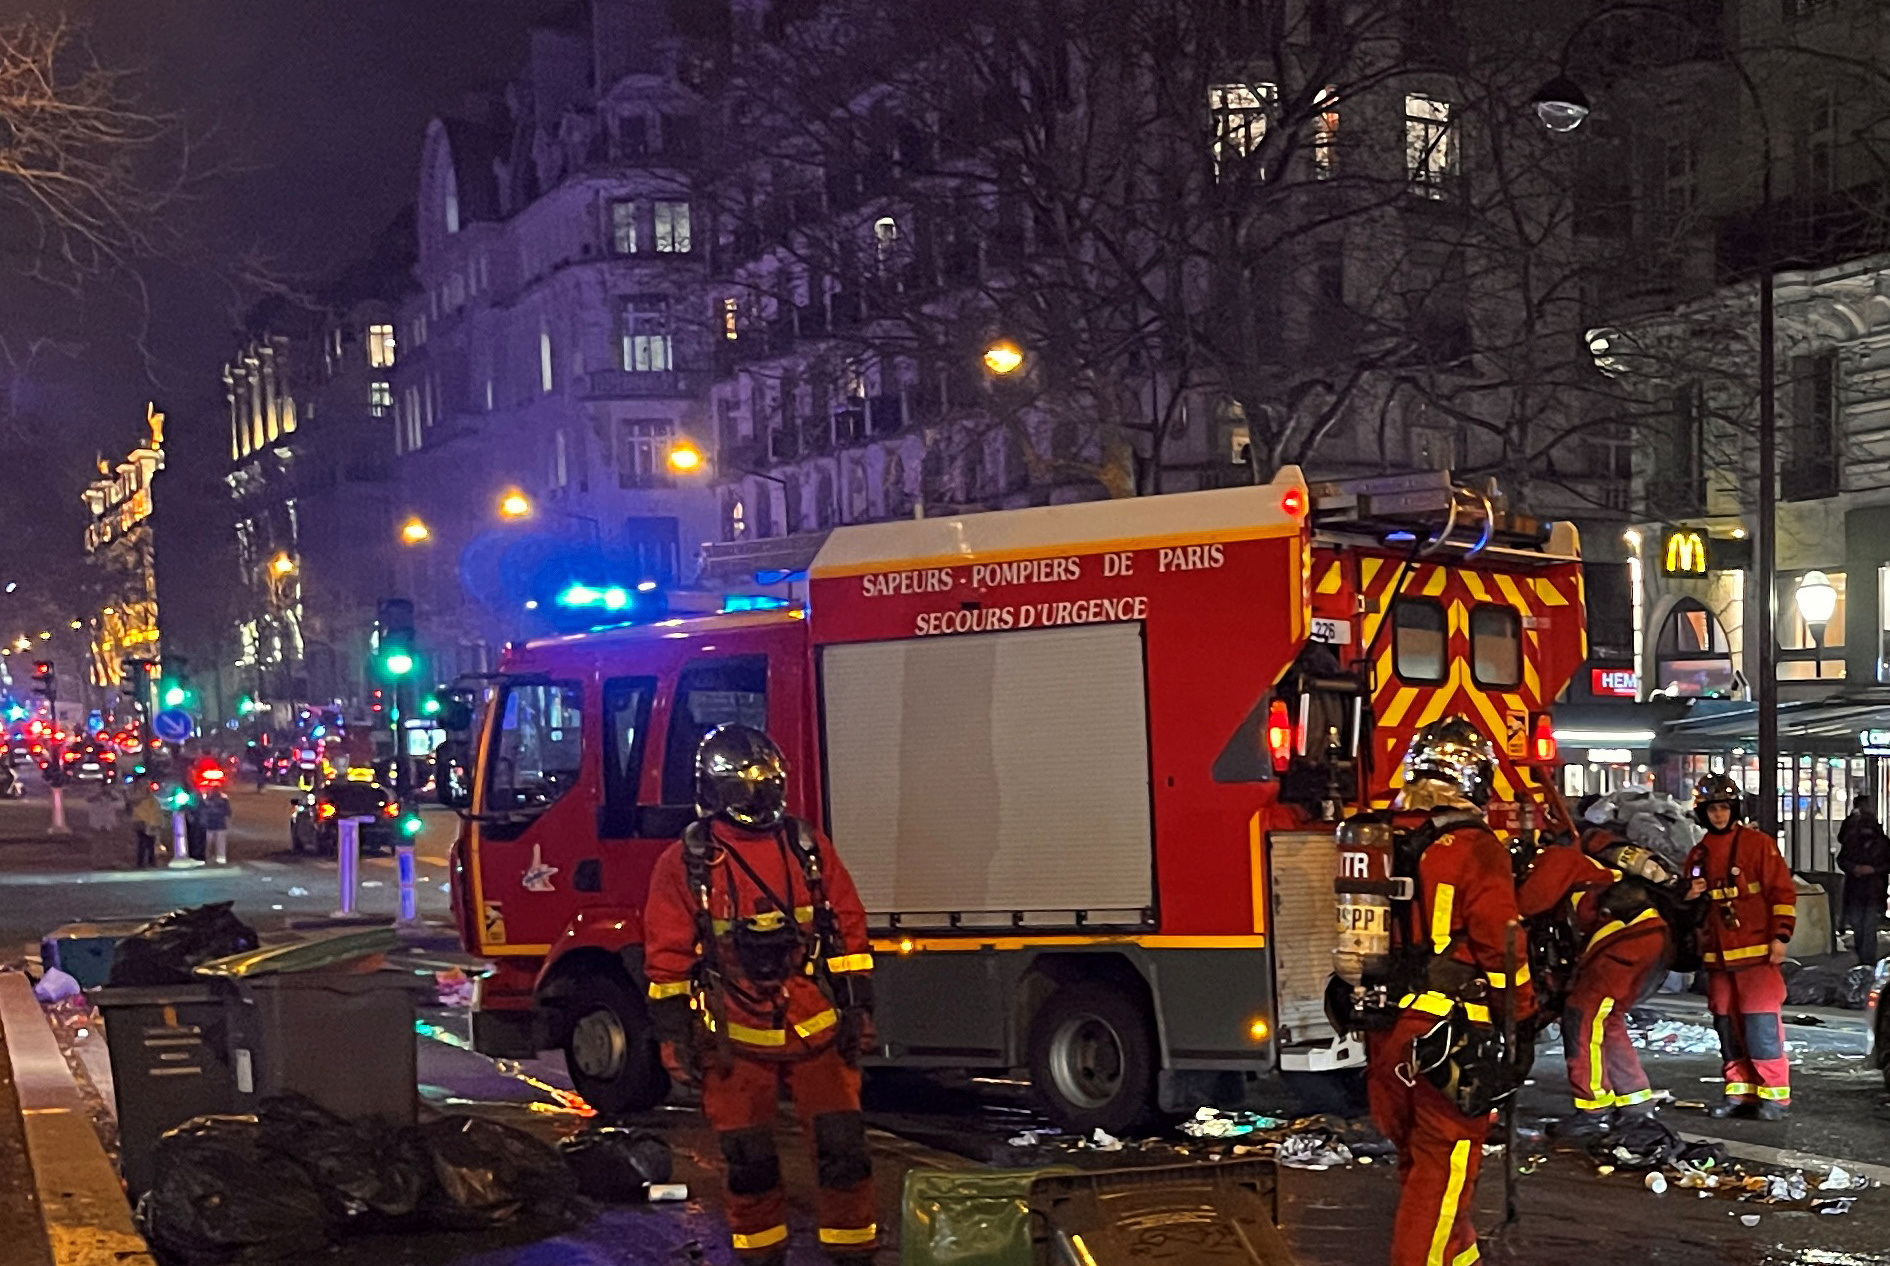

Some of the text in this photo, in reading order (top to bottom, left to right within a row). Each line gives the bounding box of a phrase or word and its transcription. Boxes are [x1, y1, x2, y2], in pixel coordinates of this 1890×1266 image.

[862, 544, 1226, 597] SAPEURS POMPIERS DE PARIS
[915, 597, 1148, 637] SECOURS D'URGENCE
[1601, 671, 1637, 689] HEM
